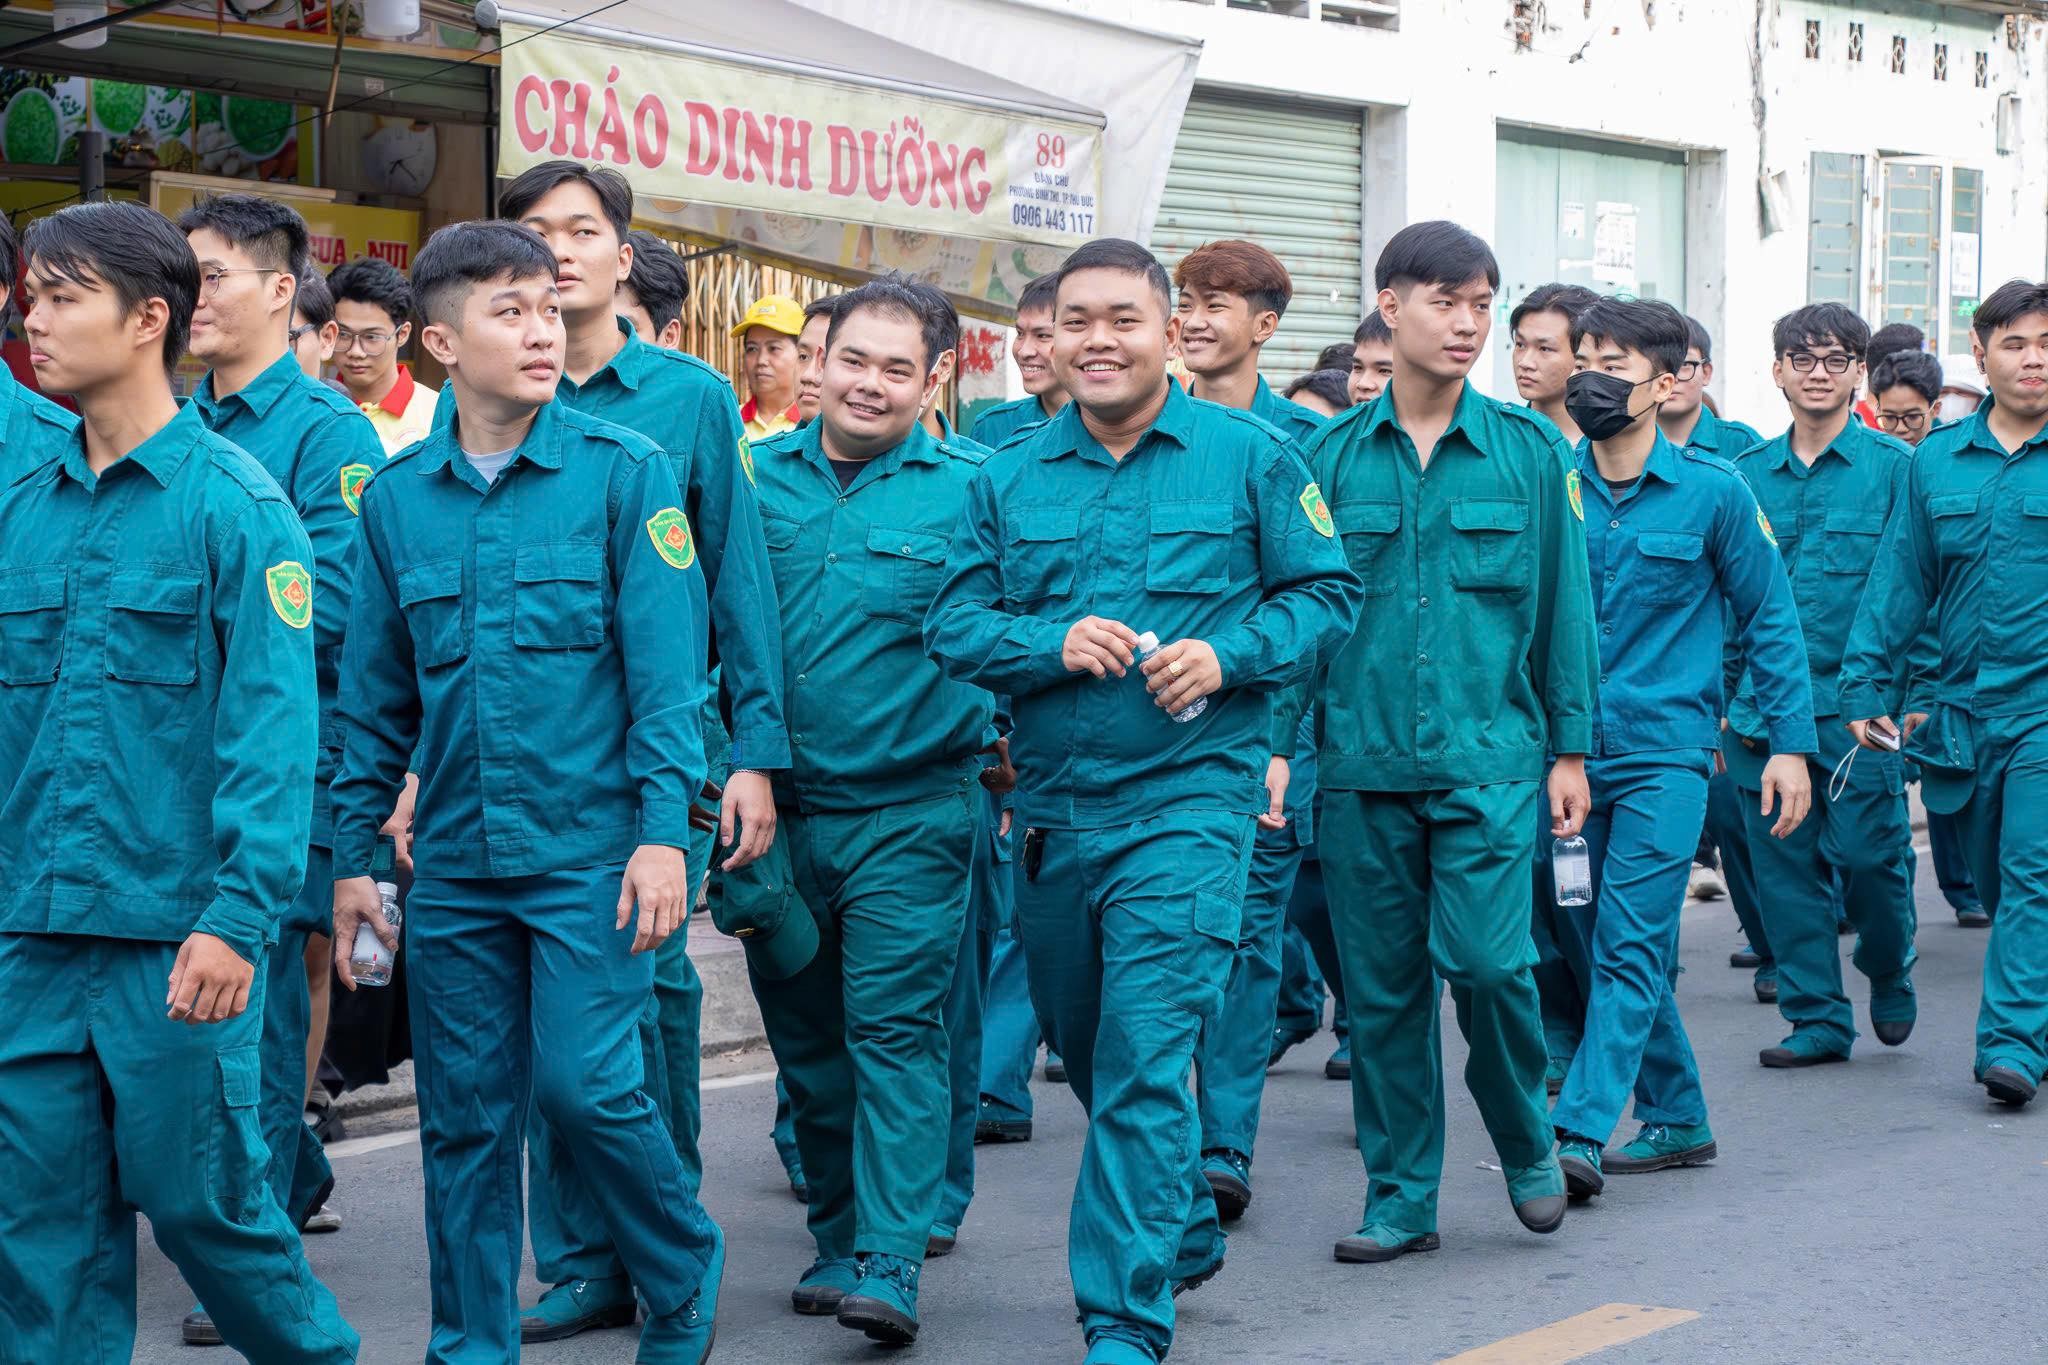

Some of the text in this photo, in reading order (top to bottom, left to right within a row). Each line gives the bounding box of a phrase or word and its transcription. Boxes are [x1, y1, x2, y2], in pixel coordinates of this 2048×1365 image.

[514, 65, 992, 215] CHÁO DINH DƯỠNG
[1036, 133, 1065, 168] 89
[1013, 204, 1094, 234] 0906 443 117
